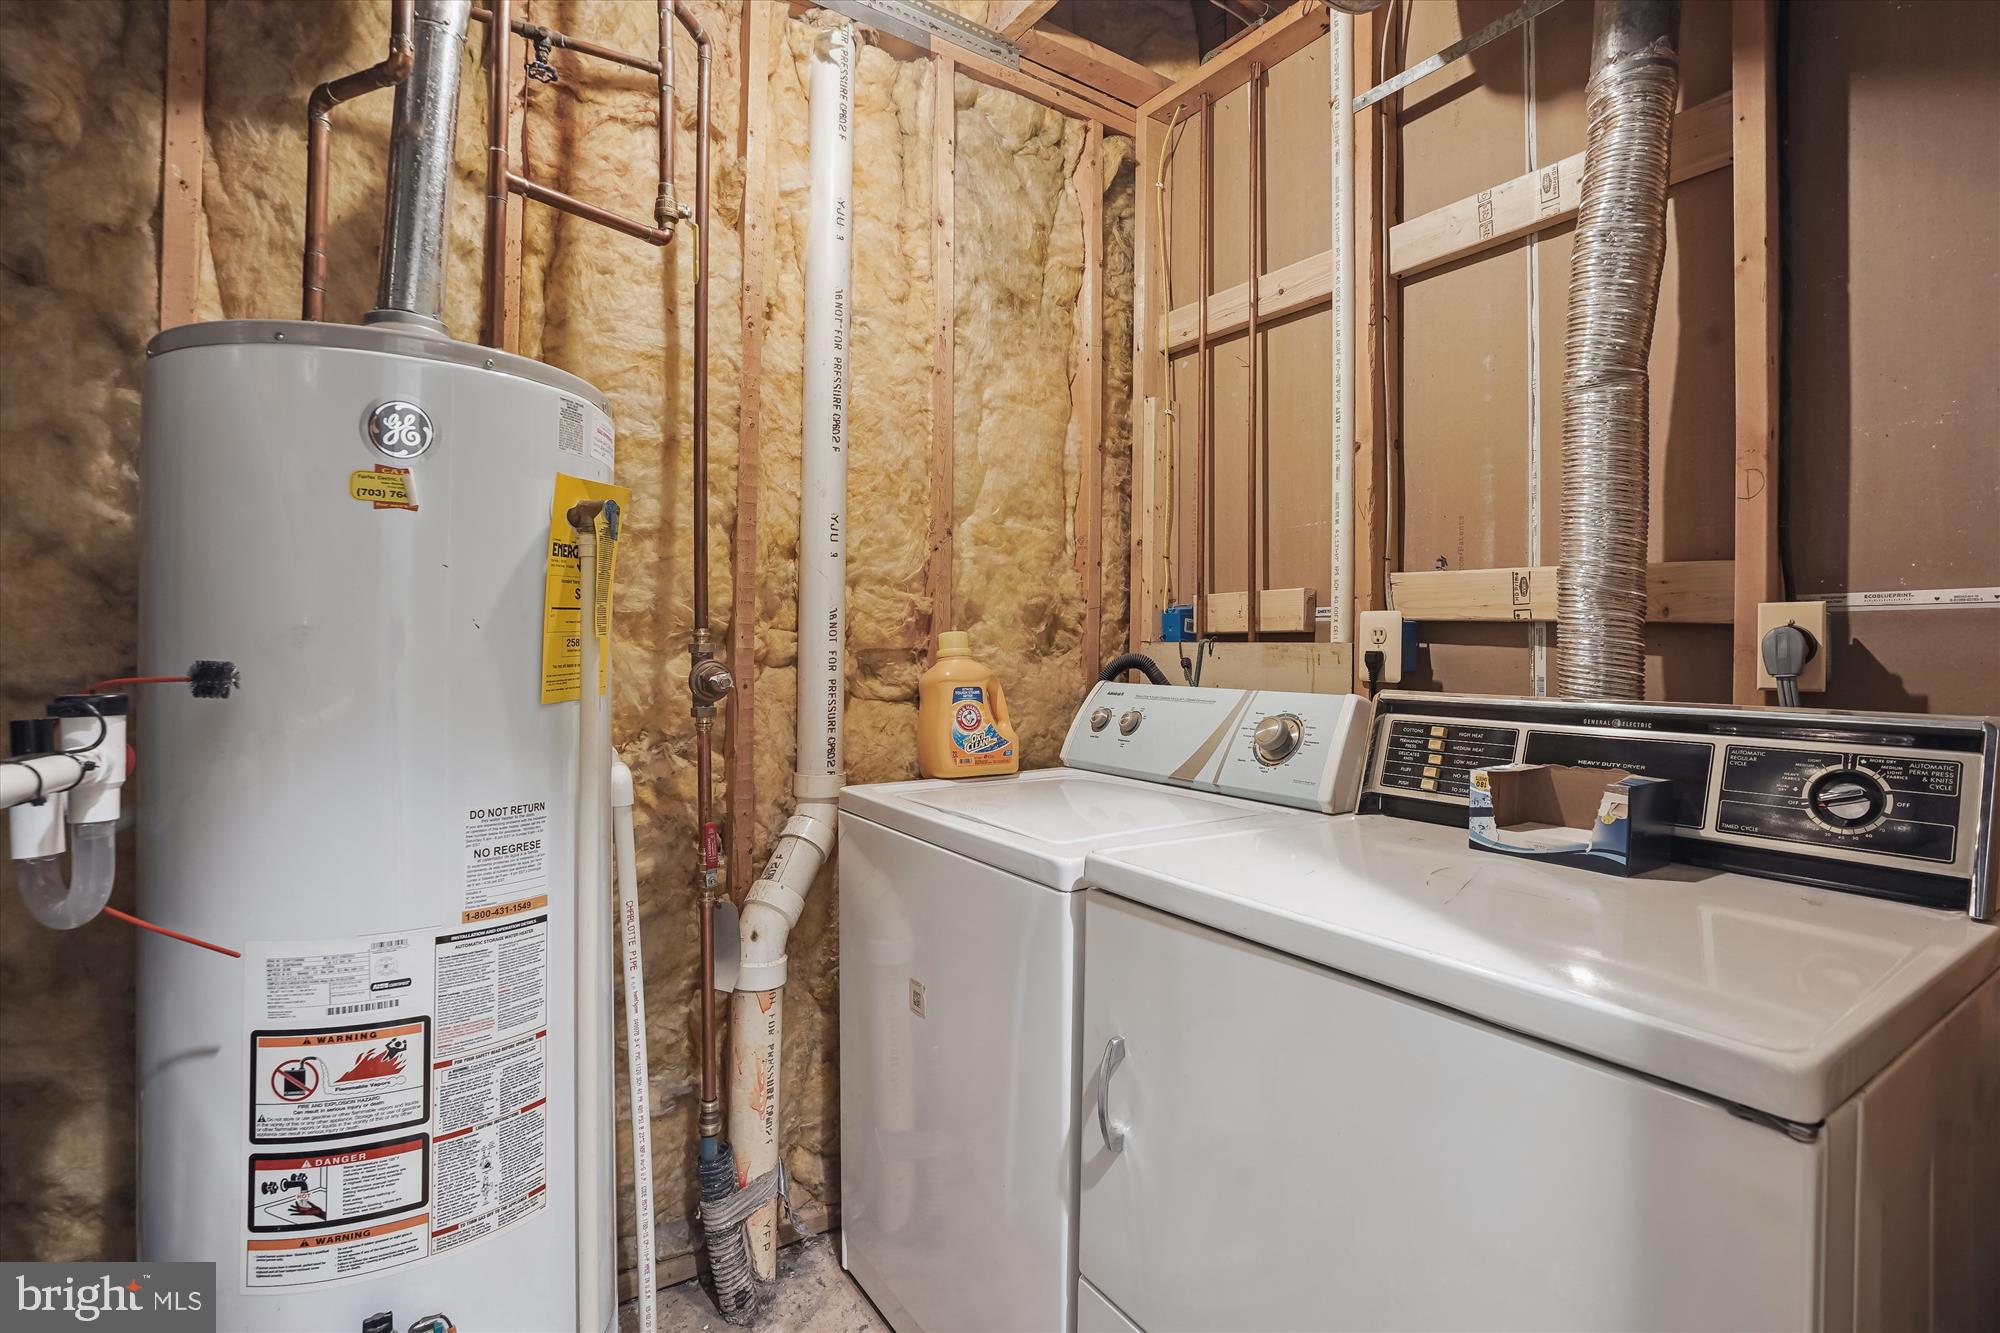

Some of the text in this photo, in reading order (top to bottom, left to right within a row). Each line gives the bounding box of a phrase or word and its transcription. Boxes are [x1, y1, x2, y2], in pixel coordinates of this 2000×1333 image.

[839, 49, 849, 102] PRESSURE
[834, 329, 842, 350] FOR
[833, 357, 842, 410] PRESSURE
[357, 488, 385, 498] (703)
[553, 542, 579, 558] ENERG
[567, 639, 580, 647] 258
[828, 651, 837, 672] FOR
[828, 679, 837, 734] PRESSURE
[966, 738, 988, 751] CLEAN
[1909, 763, 1954, 771] AUTOMATIC
[470, 802, 545, 820] DO NOT RETURN
[474, 840, 541, 858] NO REGRESE
[466, 901, 531, 920] 1-800-431-1549
[626, 900, 637, 946] CHARLOTTE
[455, 941, 483, 949] AUTOMATIC
[630, 950, 638, 971] PIPE
[316, 1031, 377, 1044] WARNING
[766, 1043, 775, 1101] PRESSURE
[335, 1080, 391, 1092] Flammable Vapors
[316, 1153, 366, 1167] DANGER
[316, 1230, 371, 1245] WARNING
